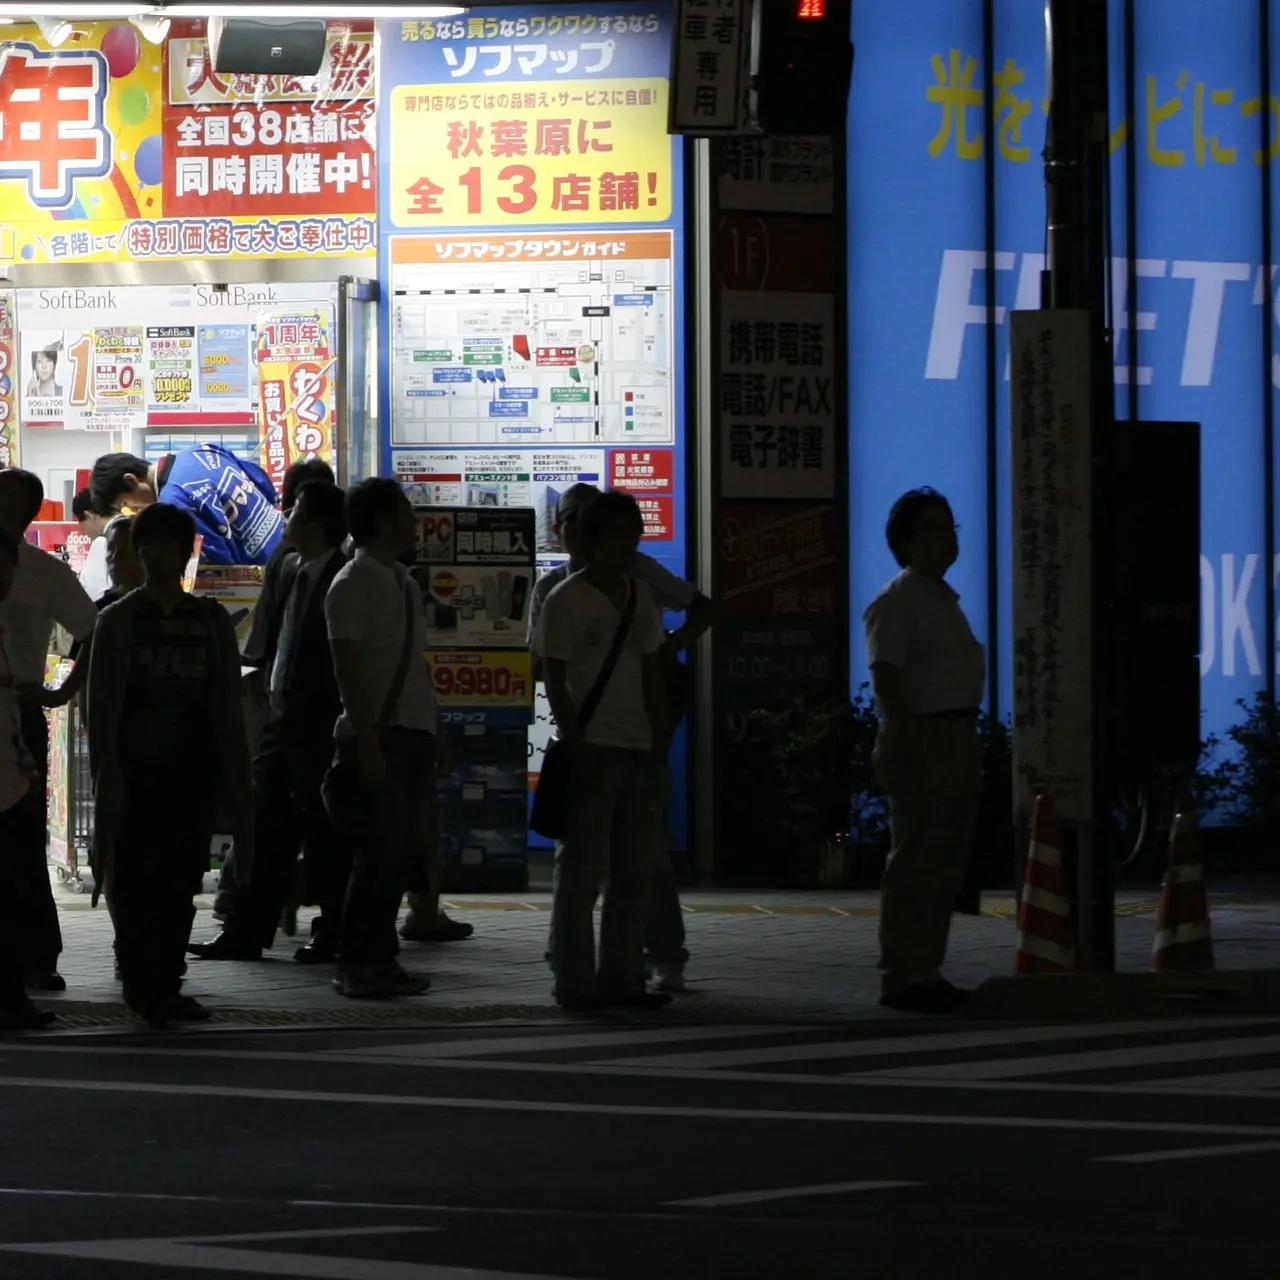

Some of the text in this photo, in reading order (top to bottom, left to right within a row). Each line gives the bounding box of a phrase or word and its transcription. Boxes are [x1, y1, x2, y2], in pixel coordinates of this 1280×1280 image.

[442, 39, 616, 77] ソフマップ
[177, 111, 374, 147] 全国38店舗に
[447, 118, 613, 159] 秋葉原に
[406, 165, 657, 215] 全13店舗!
[40, 289, 117, 310] SoftBank
[197, 286, 277, 308] SoftBank
[722, 374, 832, 417] 電話/FAX
